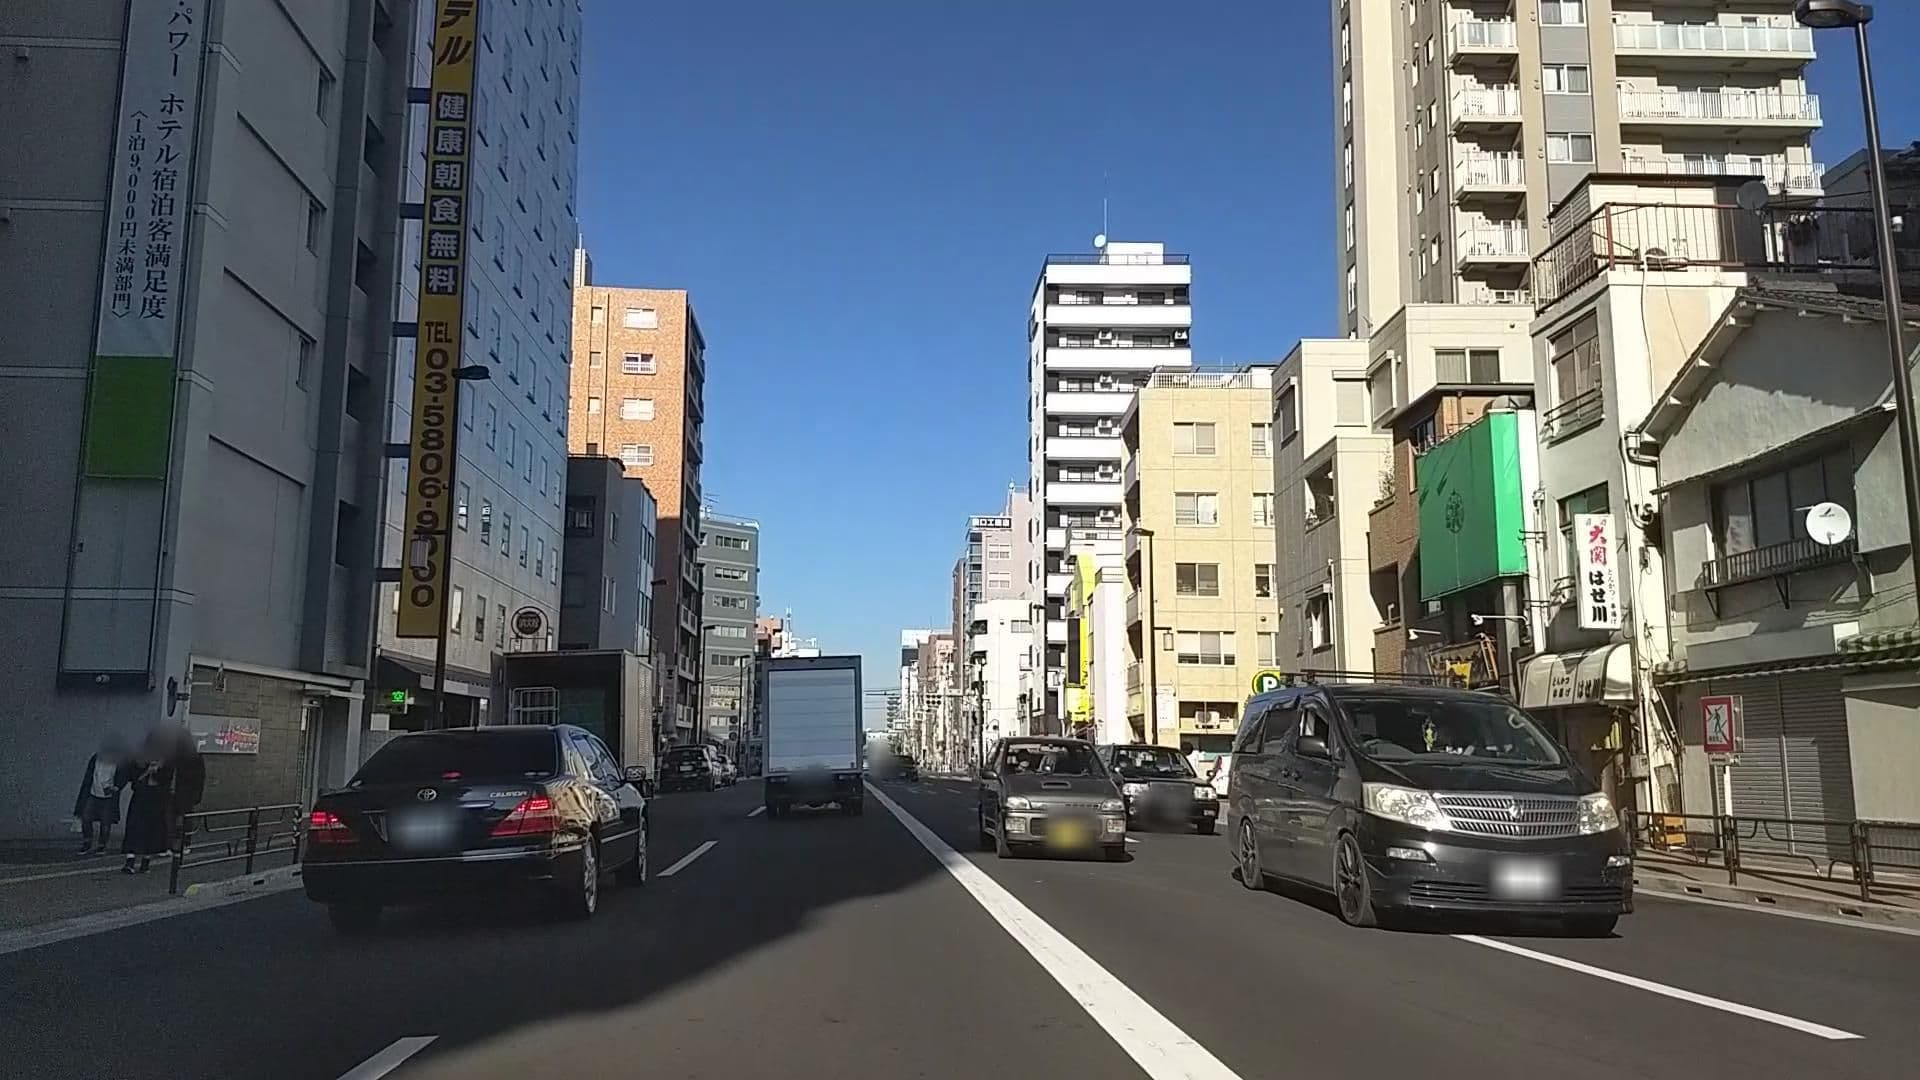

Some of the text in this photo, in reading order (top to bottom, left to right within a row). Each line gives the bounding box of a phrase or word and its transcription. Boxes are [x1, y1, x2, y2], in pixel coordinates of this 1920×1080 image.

[437, 1, 473, 66] テル
[139, 93, 185, 319] ホテル宿泊客満足度
[427, 94, 465, 293] 健康朝食無料
[425, 321, 452, 343] TEL
[1589, 525, 1607, 566] 大関
[1589, 570, 1608, 622] はせ川
[1262, 676, 1277, 692] P
